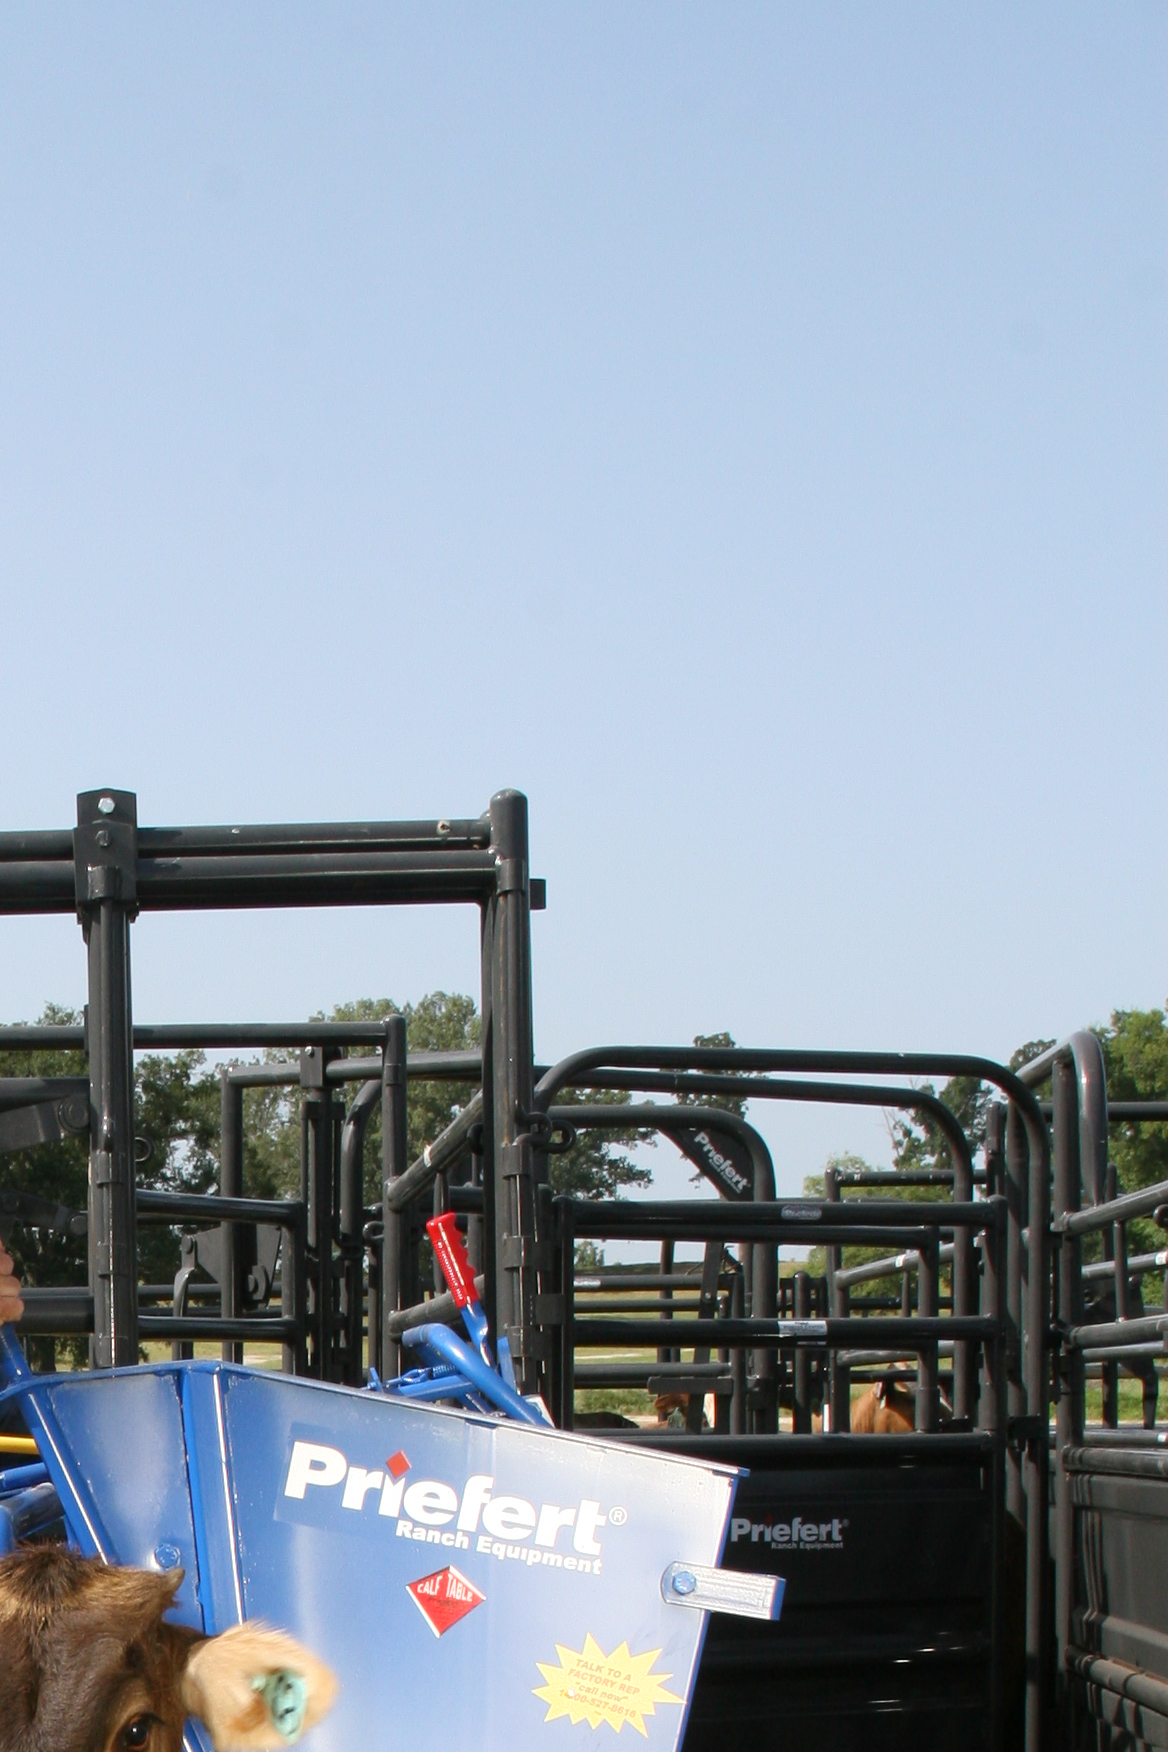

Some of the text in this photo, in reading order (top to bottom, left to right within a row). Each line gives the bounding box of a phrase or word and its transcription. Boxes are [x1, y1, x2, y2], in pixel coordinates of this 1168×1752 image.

[395, 1519, 603, 1575] Ranch Equipment
[800, 1542, 844, 1550] Equipment
[417, 1573, 473, 1602] CALF TABLE
[567, 1667, 641, 1696] FACTORY REP
[575, 1658, 632, 1683] TALK TO A
